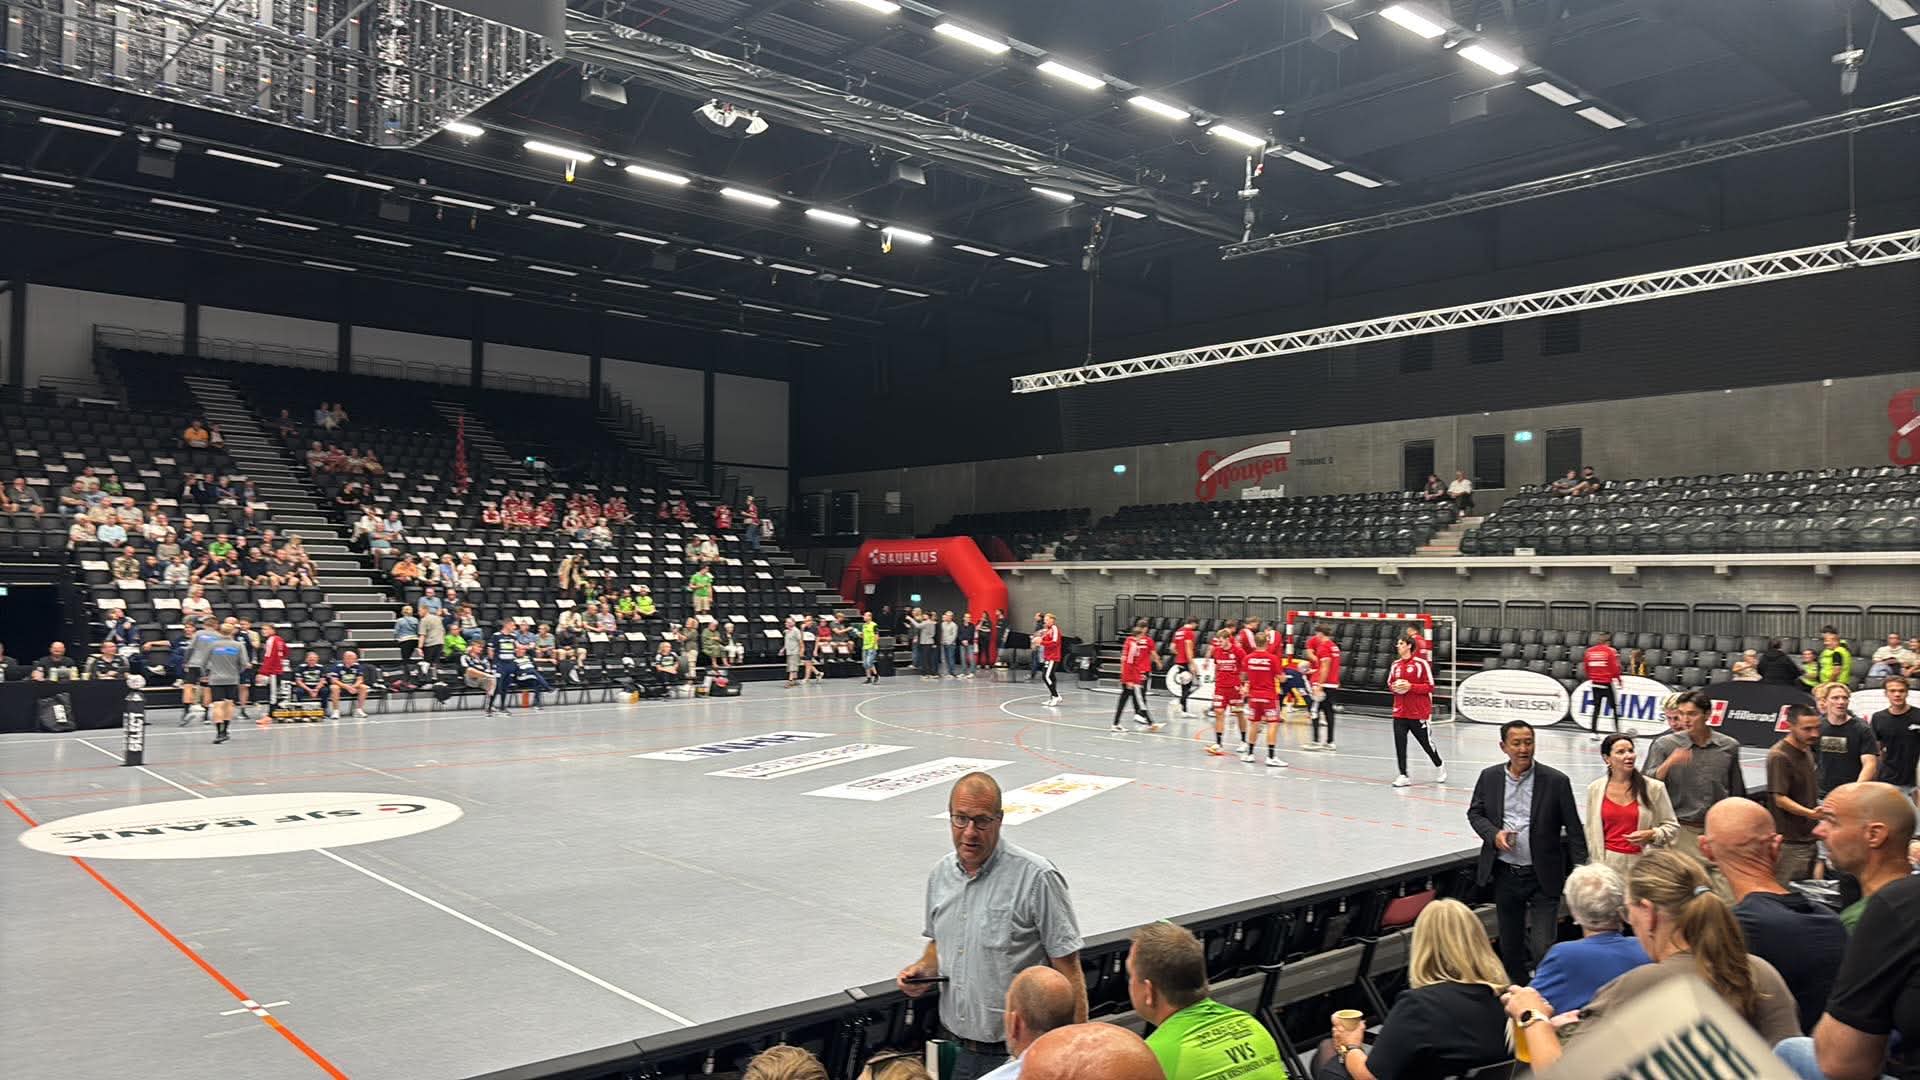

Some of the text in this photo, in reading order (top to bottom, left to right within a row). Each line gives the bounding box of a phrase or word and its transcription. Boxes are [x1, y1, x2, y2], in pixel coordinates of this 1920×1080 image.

[880, 551, 937, 564] BAUHAUS
[1463, 696, 1555, 711] BØRGE NIELSEN
[274, 808, 361, 823] SJF
[64, 819, 258, 843] BANK
[1224, 1042, 1256, 1063] VVS
